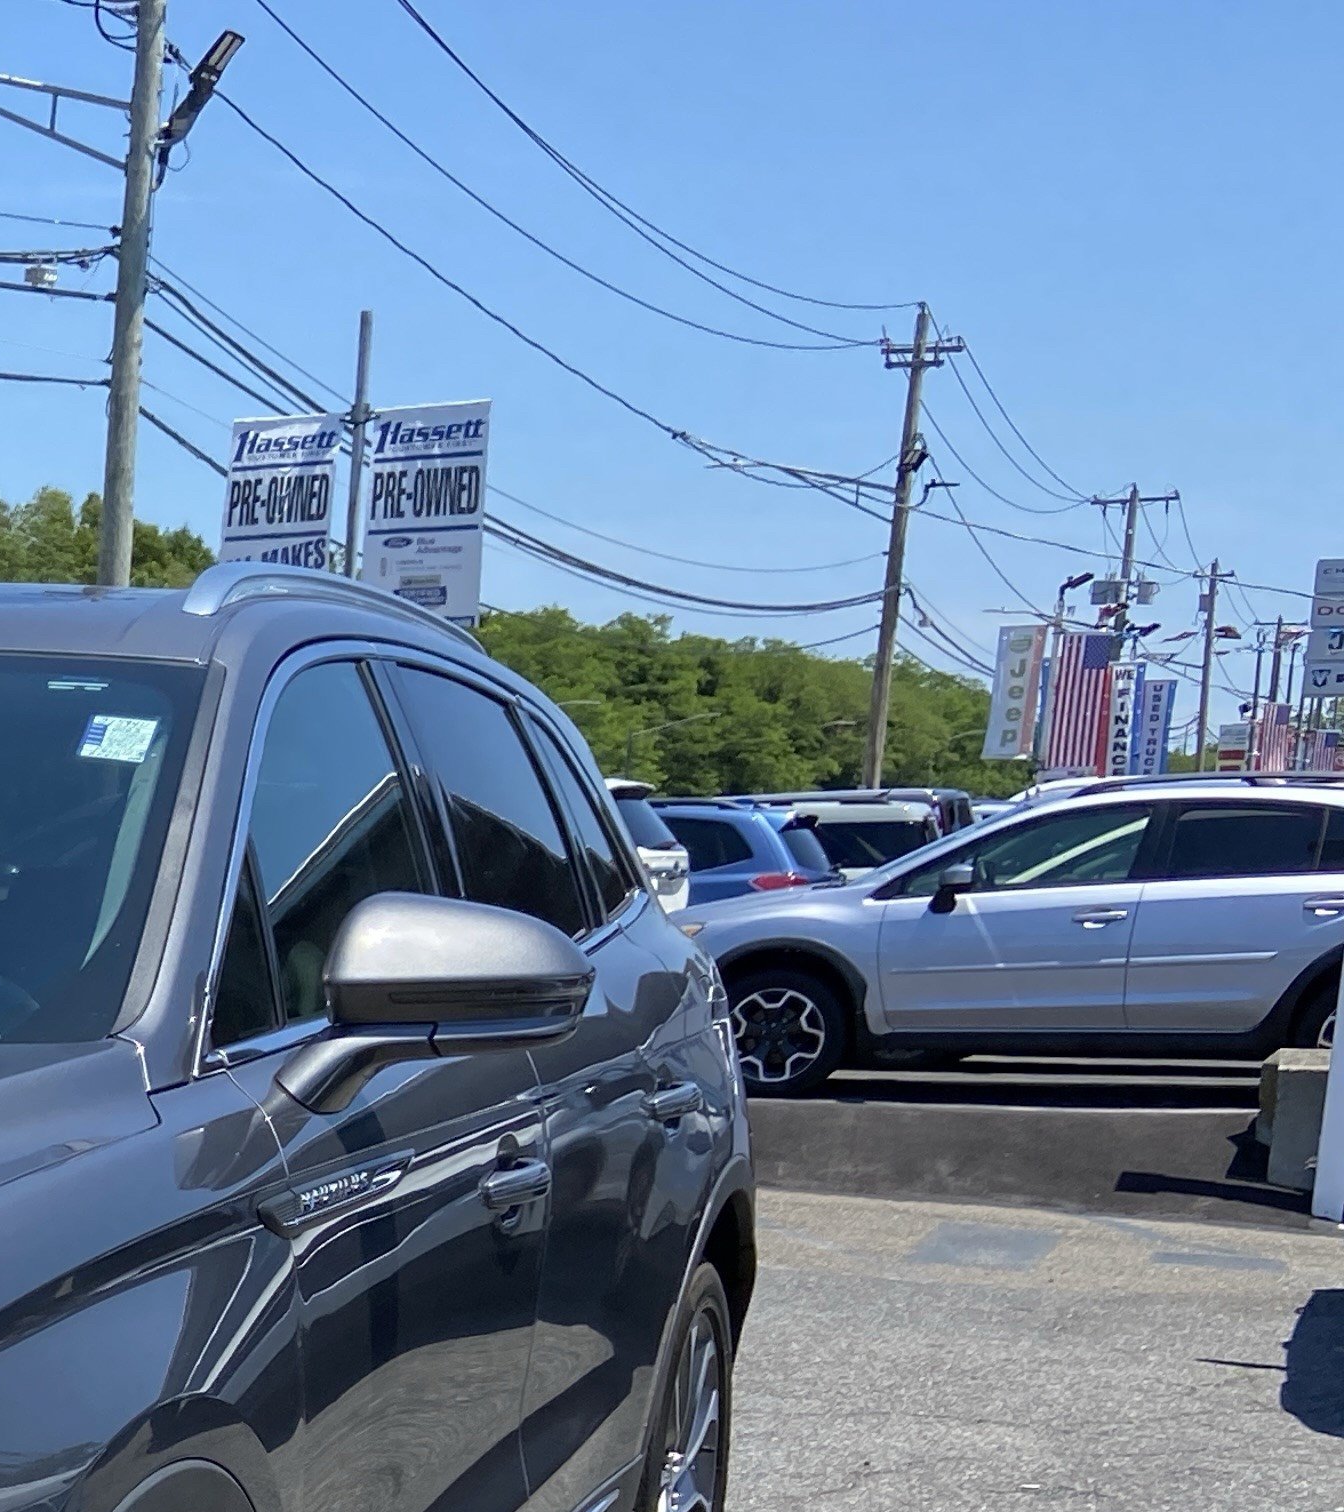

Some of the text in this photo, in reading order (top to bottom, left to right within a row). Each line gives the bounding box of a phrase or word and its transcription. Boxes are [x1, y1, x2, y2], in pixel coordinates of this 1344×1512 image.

[227, 473, 330, 528] PRE-OWNED
[370, 465, 481, 521] PRE-OWNED
[1115, 668, 1135, 681] WE
[999, 658, 1028, 749] Jeep
[1149, 684, 1163, 723] USED
[1112, 687, 1130, 776] FINANCE
